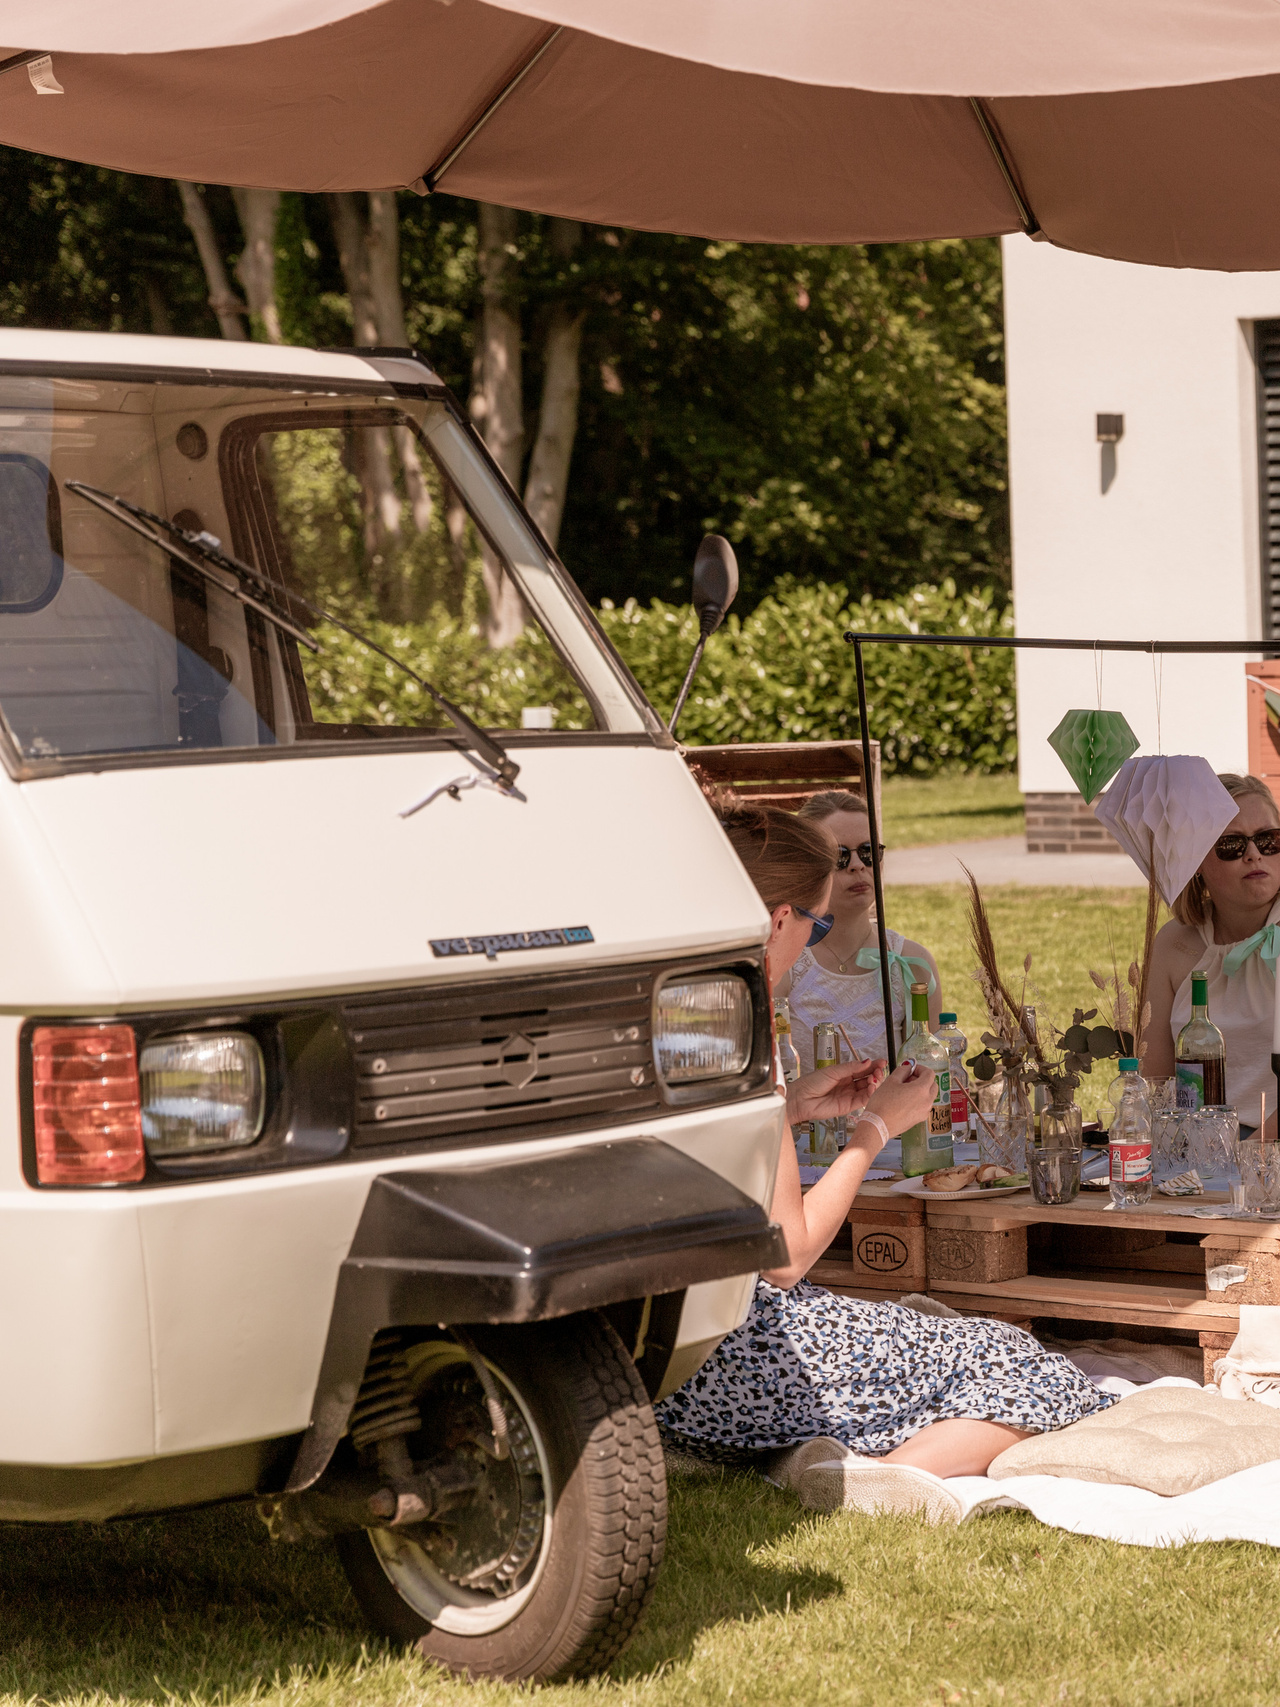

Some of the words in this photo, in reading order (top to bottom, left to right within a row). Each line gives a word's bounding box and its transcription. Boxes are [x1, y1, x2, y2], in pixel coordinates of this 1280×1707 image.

[431, 928, 562, 958] vespacar
[564, 926, 592, 943] tm
[865, 1241, 902, 1264] EPAL
